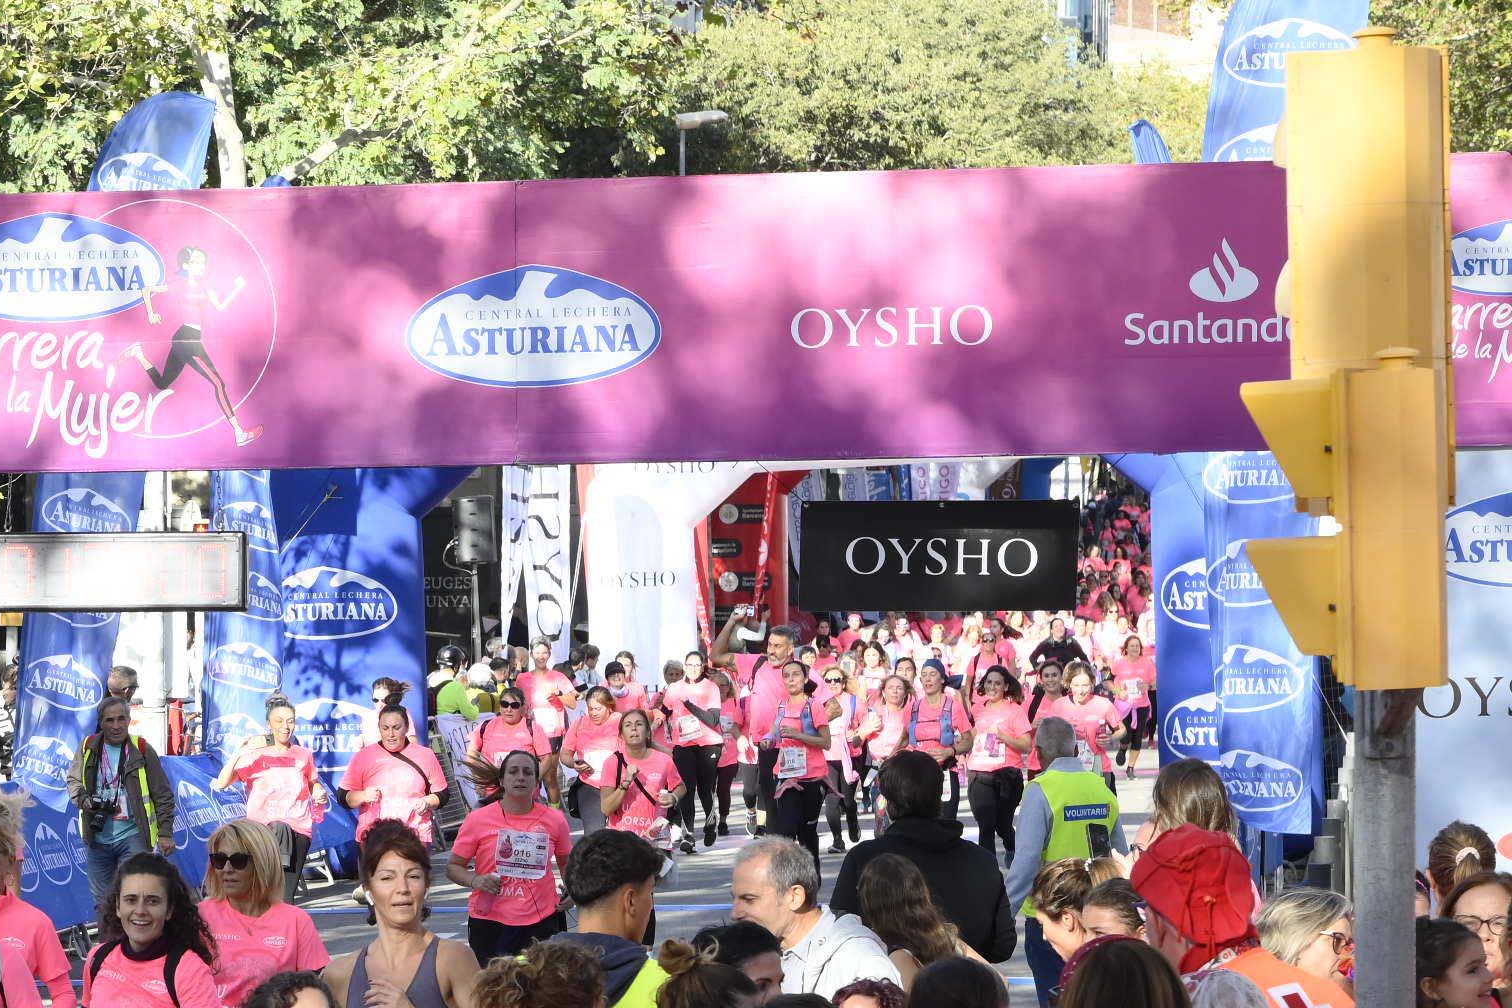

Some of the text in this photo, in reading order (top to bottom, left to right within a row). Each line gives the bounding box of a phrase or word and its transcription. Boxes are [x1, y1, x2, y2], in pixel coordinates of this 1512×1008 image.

[1232, 44, 1286, 71] ASTU
[464, 304, 632, 321] CENTRAL LECHERA
[1452, 302, 1512, 331] arre
[426, 313, 641, 358] ASTURIANA
[790, 304, 993, 349] OYSHO
[1124, 312, 1293, 346] Santand
[1474, 331, 1492, 359] la
[6, 376, 32, 413] la
[25, 363, 175, 459] Mujer
[1472, 524, 1512, 534] CENT
[845, 535, 1039, 578] OYSHO
[424, 577, 472, 590] EUGES
[1184, 580, 1207, 588] CEN
[288, 591, 384, 600] CENTRAL LECHERA
[426, 595, 472, 608] UNYA
[1168, 582, 1207, 610] AST
[285, 602, 388, 623] STURIANA
[1224, 677, 1293, 695] URIANA
[294, 723, 363, 732] ENTRAL LECH
[1186, 716, 1217, 724] CENT
[1170, 717, 1219, 746] ASTU
[1065, 807, 1107, 818] VOLUNTARIS
